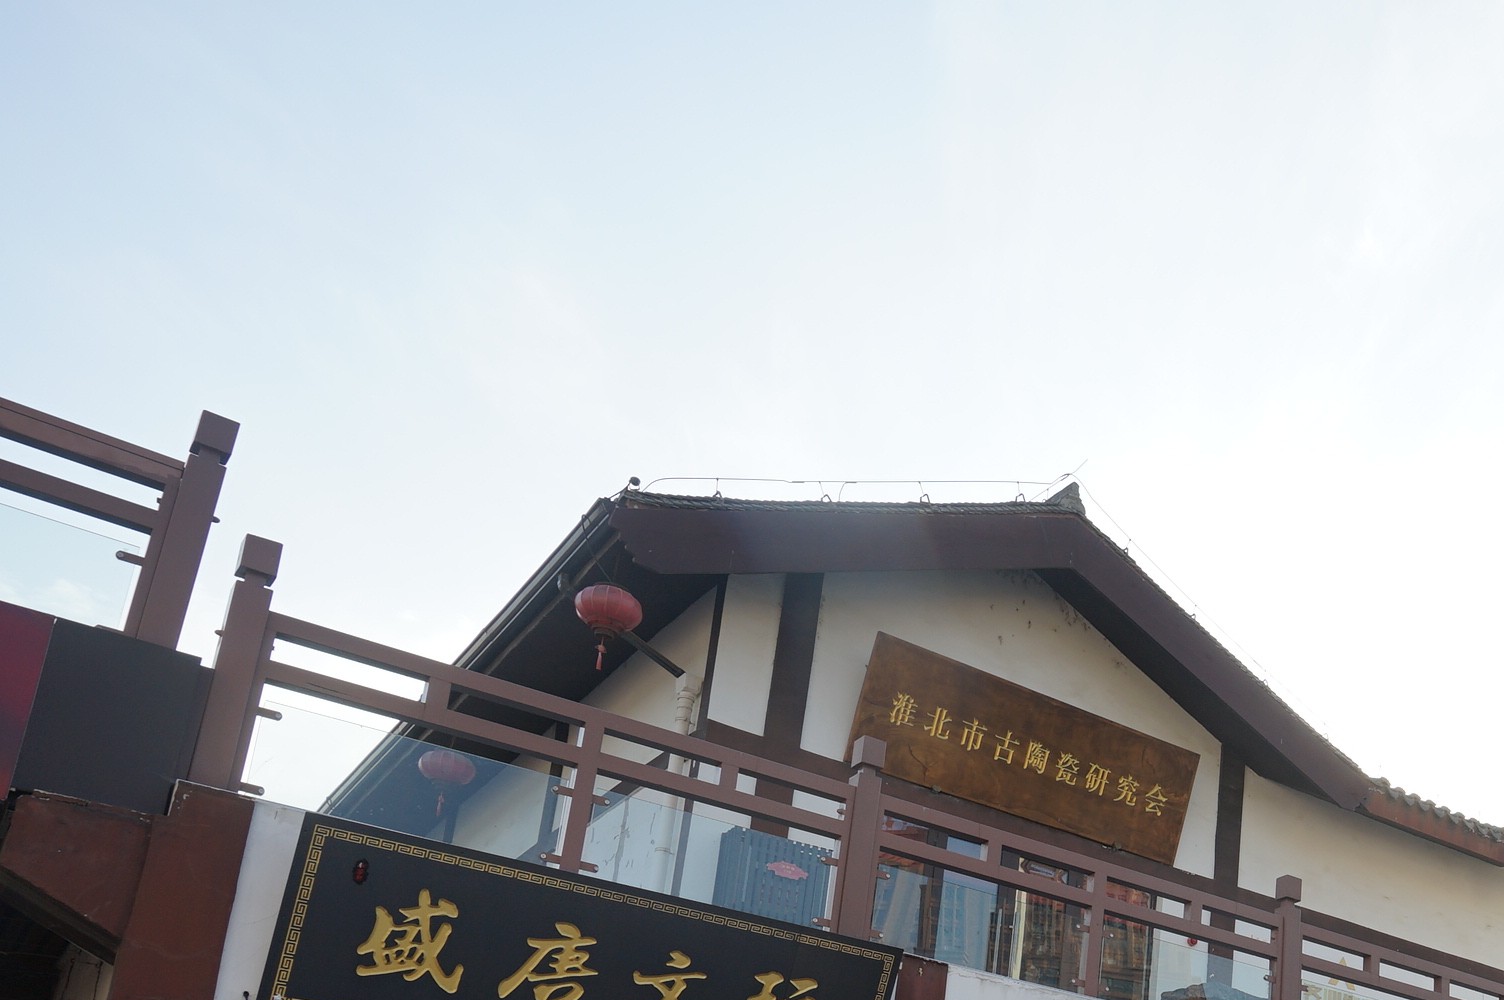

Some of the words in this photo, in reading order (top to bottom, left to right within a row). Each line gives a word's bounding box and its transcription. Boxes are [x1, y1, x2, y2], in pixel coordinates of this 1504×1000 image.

[888, 691, 1169, 817] 淮北市古陶瓷研究会
